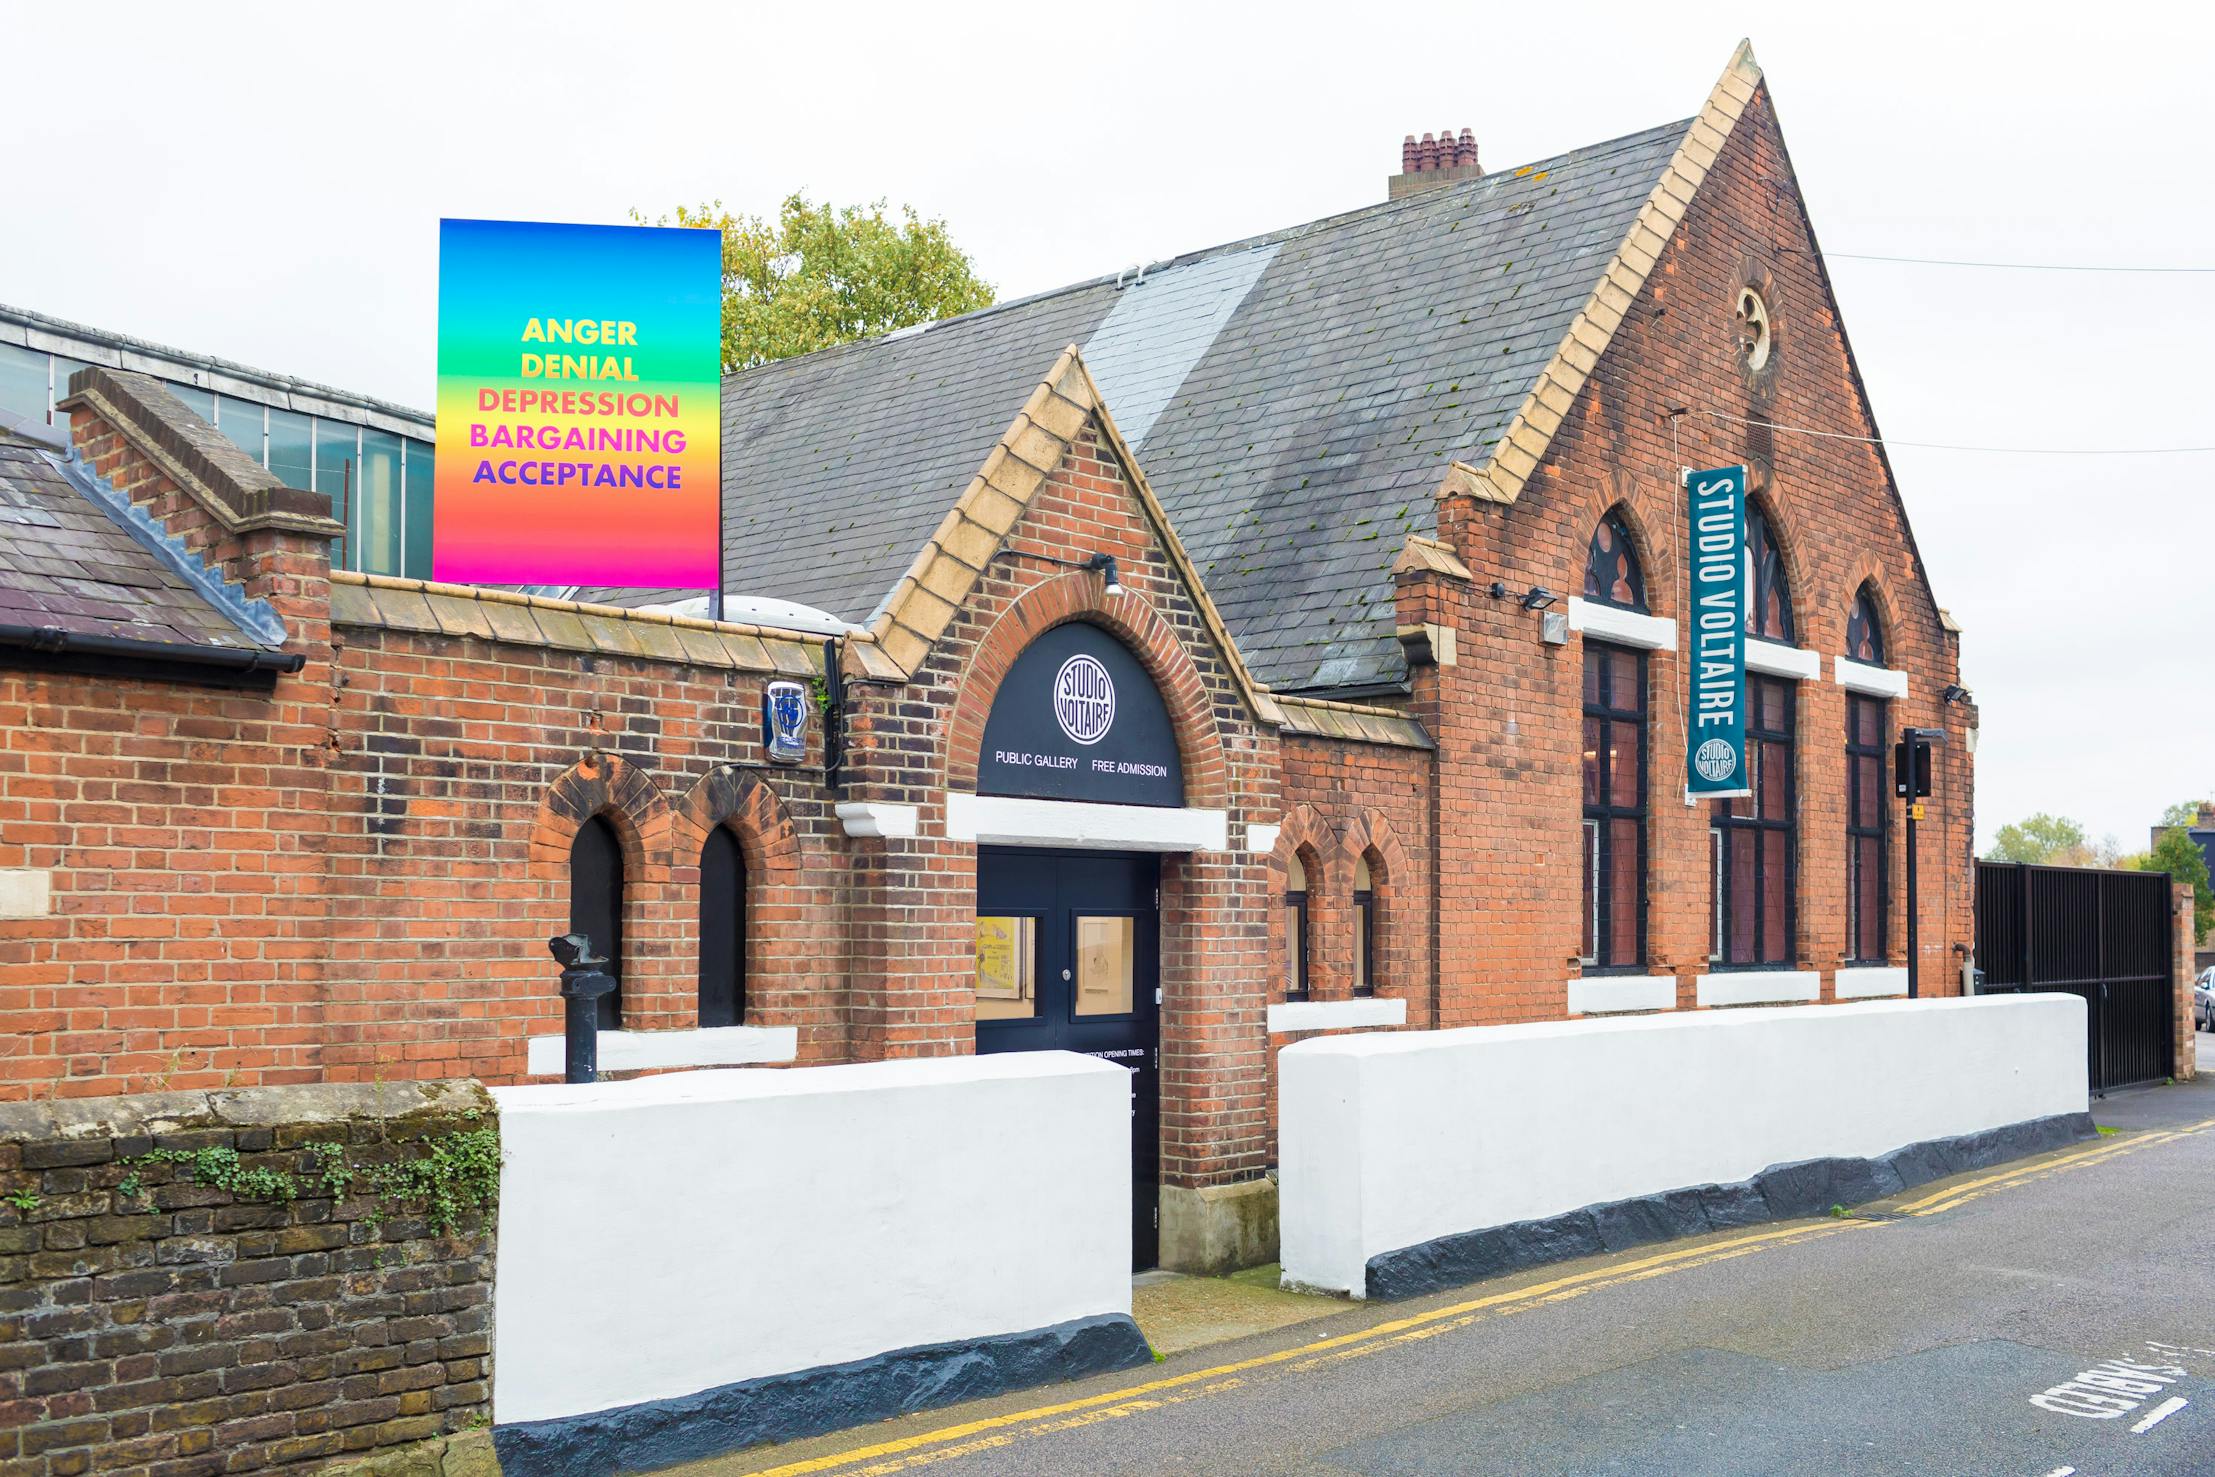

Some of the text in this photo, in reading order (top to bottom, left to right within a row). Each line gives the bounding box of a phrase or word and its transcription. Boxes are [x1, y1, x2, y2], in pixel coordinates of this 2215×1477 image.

[521, 317, 638, 346] ANGER
[521, 353, 639, 381] DENIAL
[479, 388, 680, 418] DEPRESSION
[470, 424, 687, 454] BARGAINING
[473, 460, 681, 489] ACCEPTANCE
[1697, 478, 1736, 728] STUDIO VOLTAIRE
[1064, 663, 1105, 700] STUDIO
[995, 750, 1078, 769] PUBLIC GALLERY
[1700, 742, 1730, 760] STUDIO
[1092, 759, 1168, 777] FREE ADMISSION
[1103, 1050, 1128, 1059] OPENING
